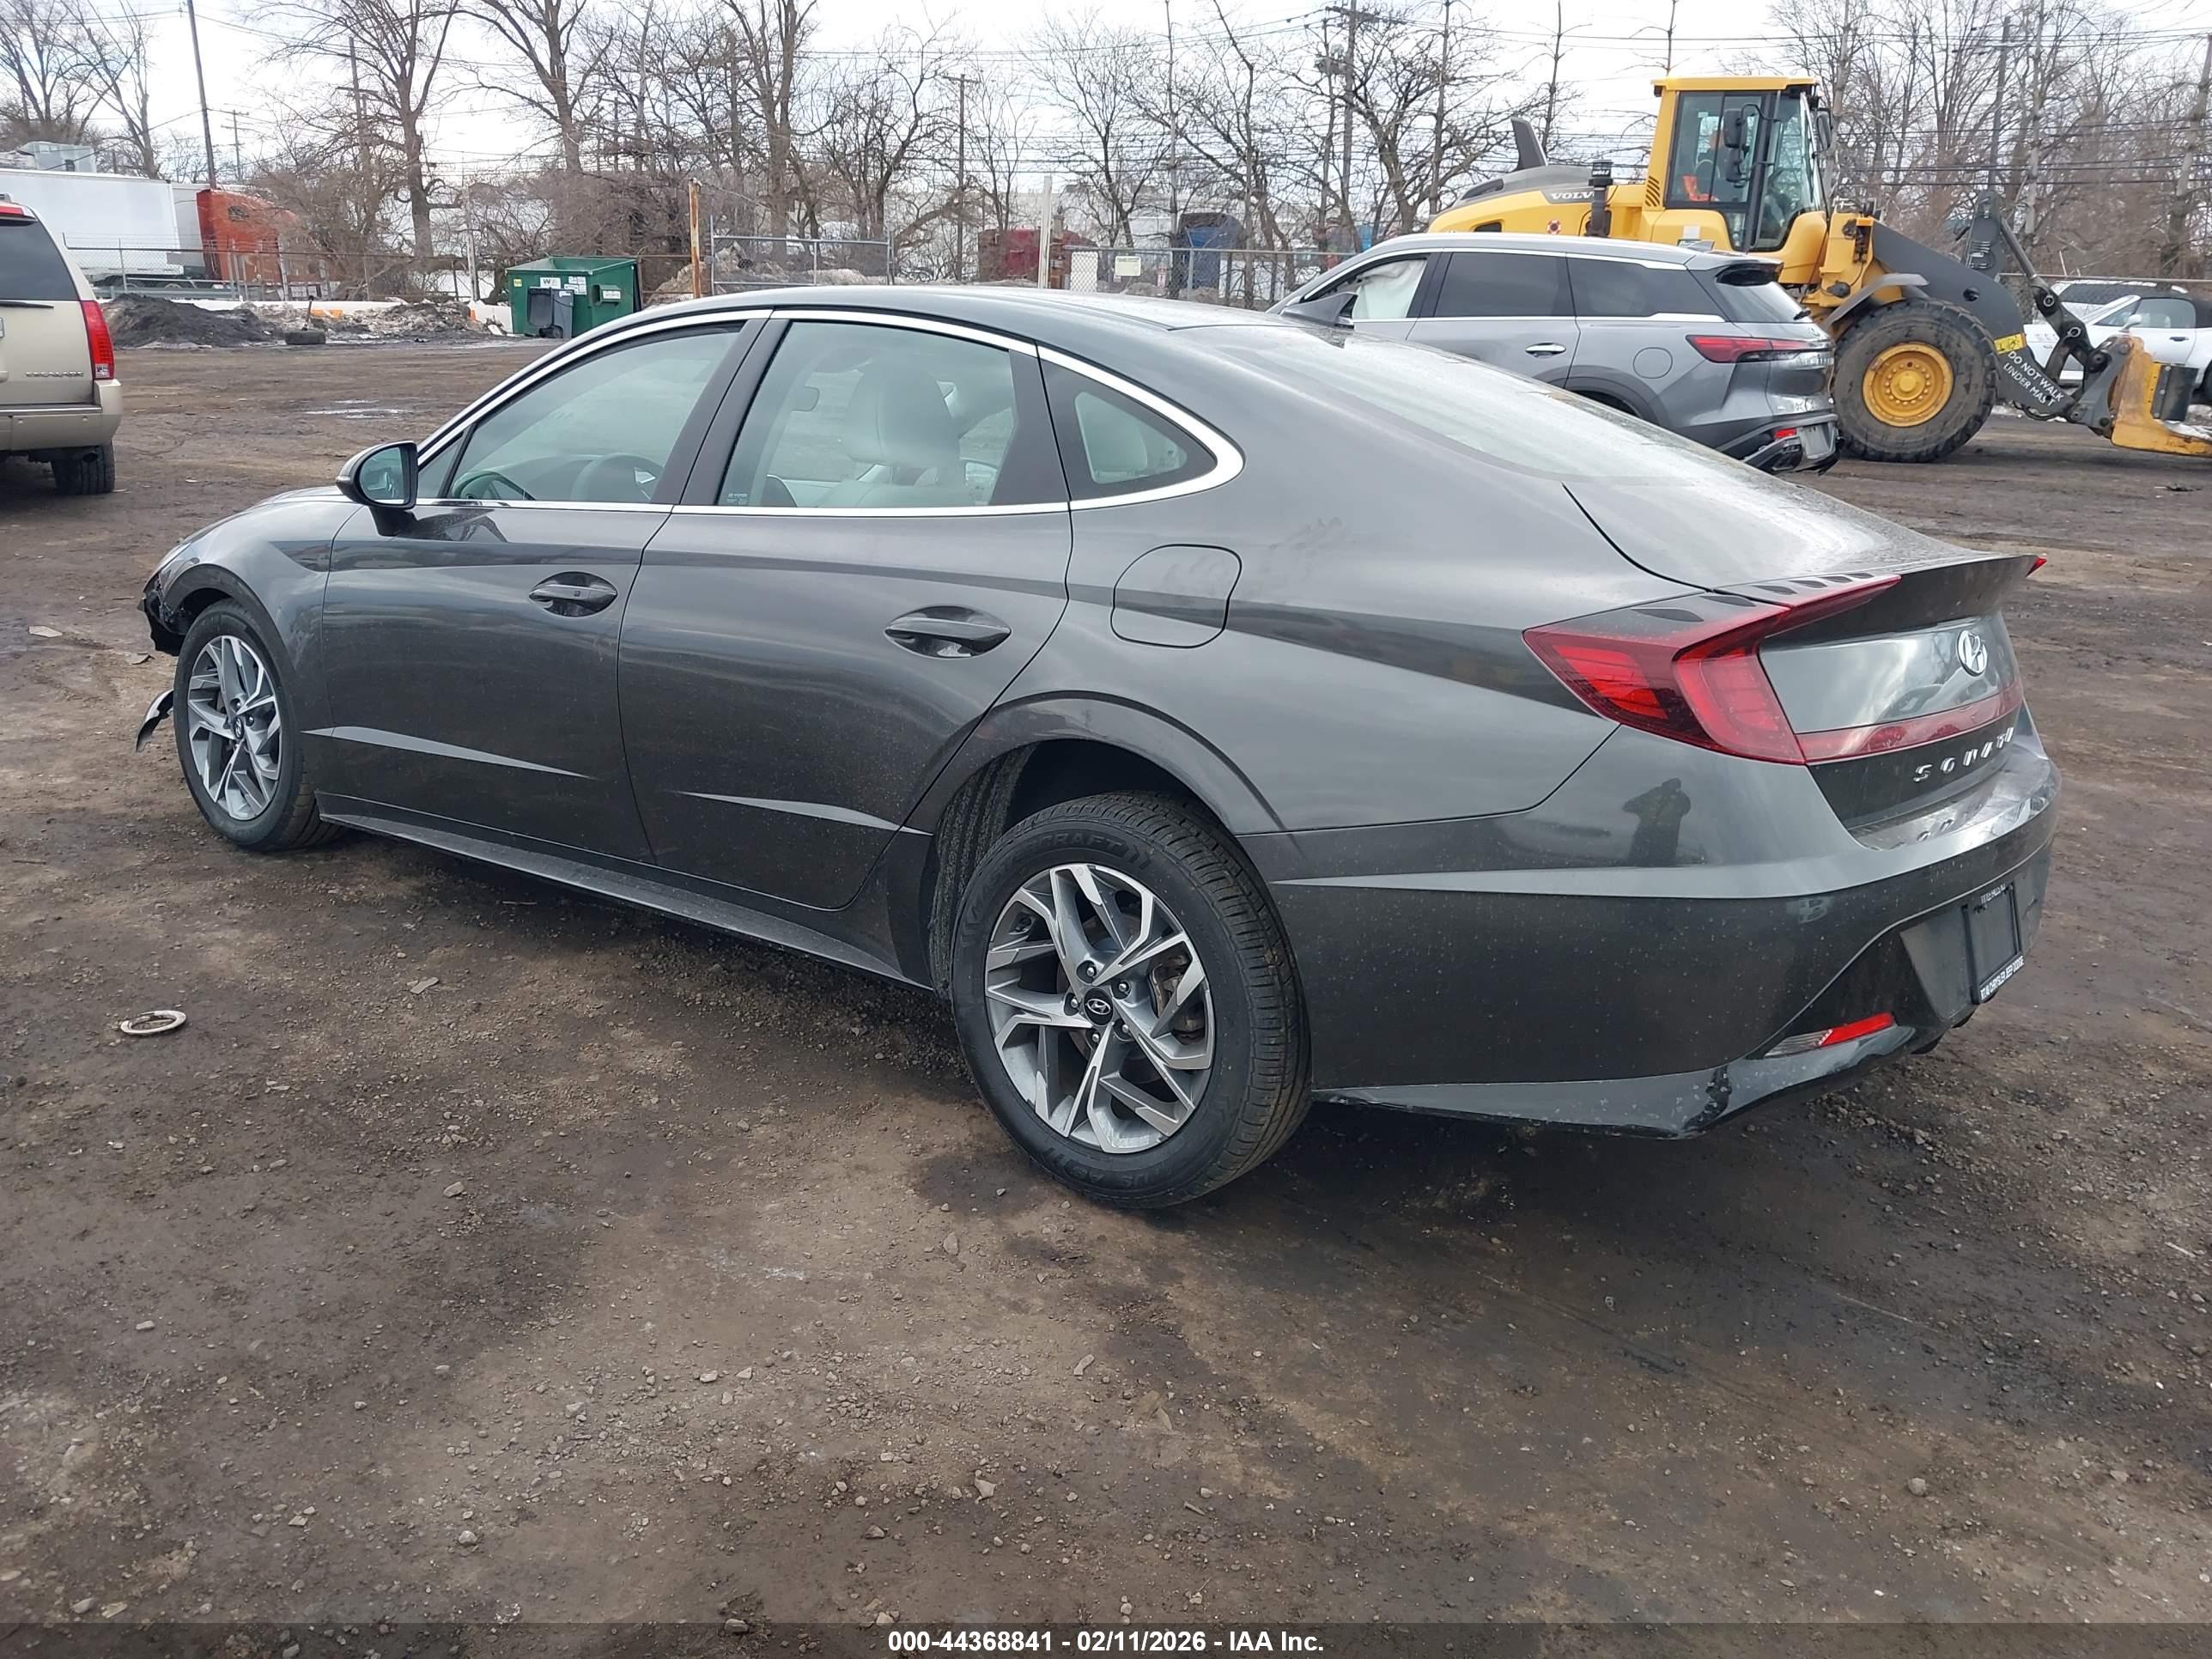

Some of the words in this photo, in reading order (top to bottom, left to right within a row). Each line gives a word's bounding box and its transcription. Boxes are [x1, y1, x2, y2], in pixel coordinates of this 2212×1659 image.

[1551, 191, 1595, 200] VOLV
[2002, 362, 2032, 389] UNDER
[2029, 386, 2056, 407] MAST
[2008, 350, 2023, 364] DO
[2021, 362, 2042, 380] NOT
[2039, 377, 2064, 402] WALK
